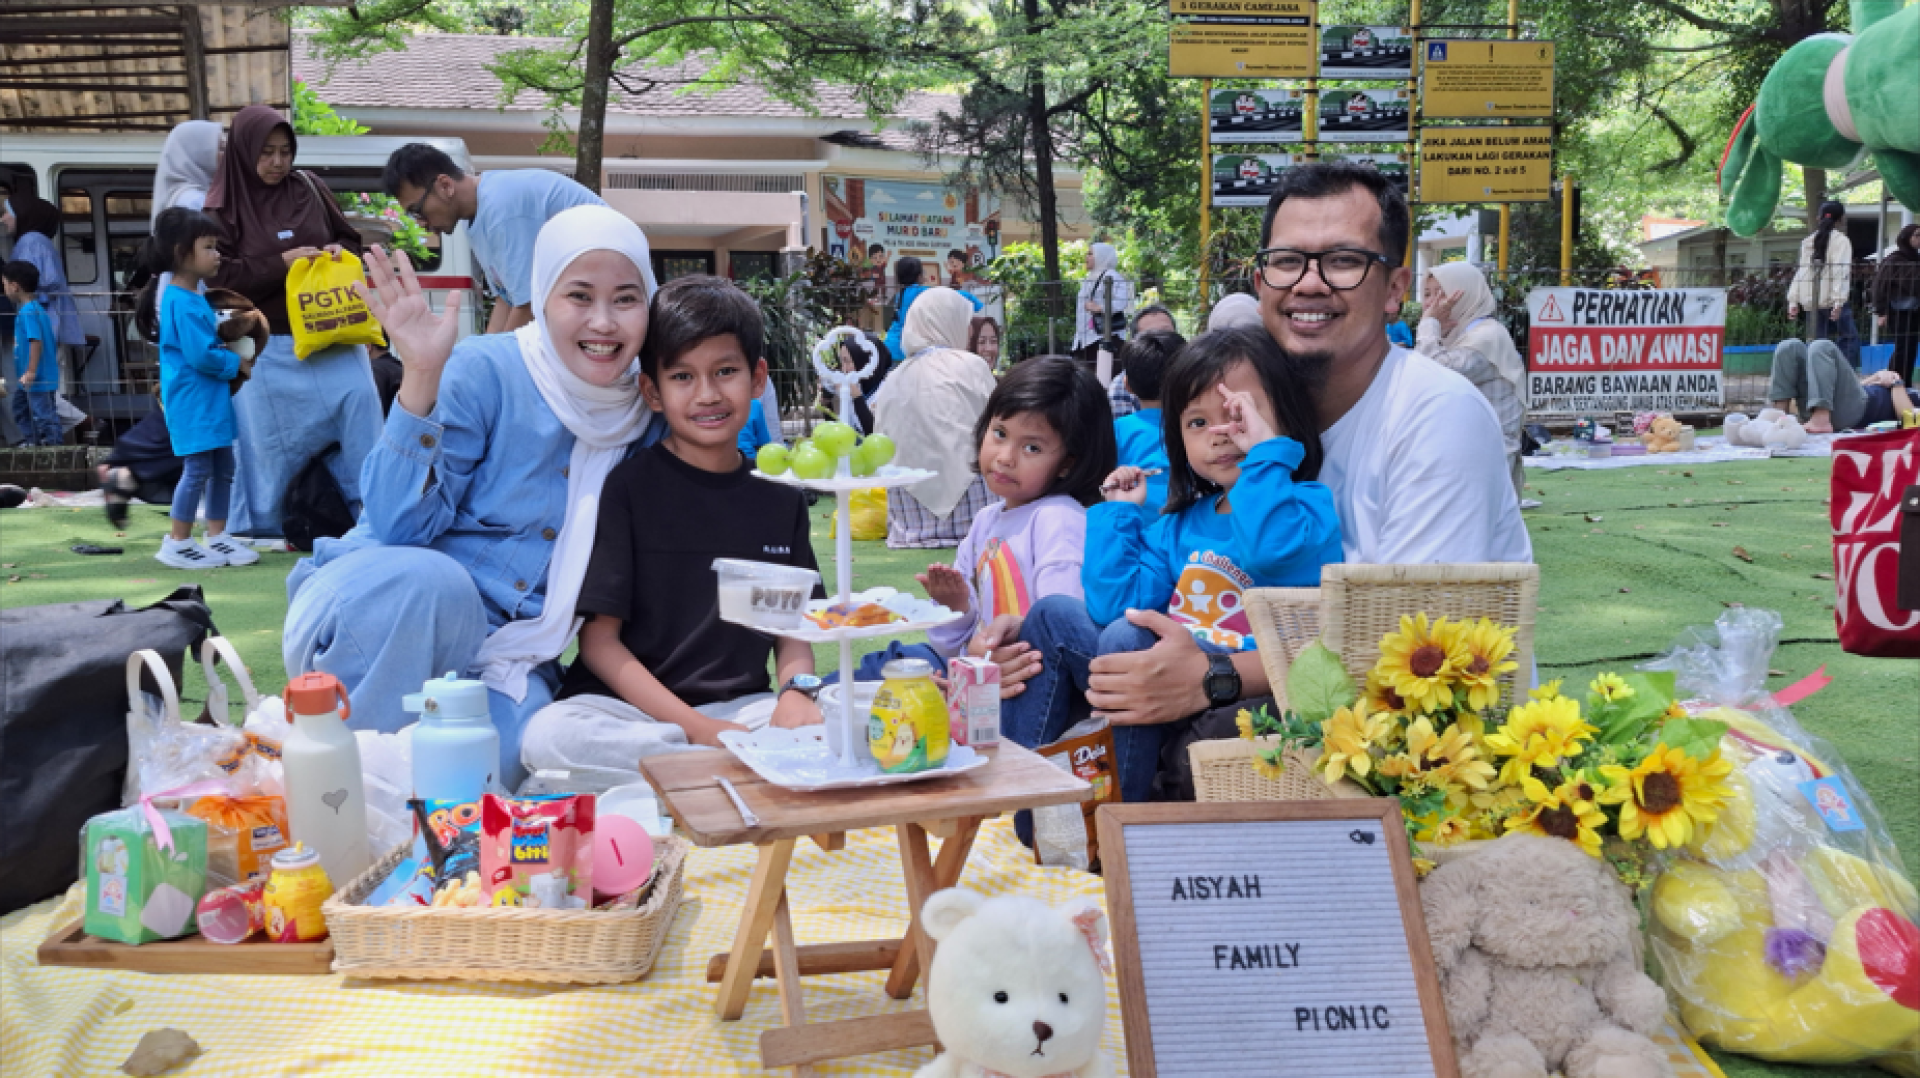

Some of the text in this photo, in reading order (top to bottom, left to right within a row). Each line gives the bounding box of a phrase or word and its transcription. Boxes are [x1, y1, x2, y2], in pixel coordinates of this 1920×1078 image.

[1189, 1, 1241, 11] GERAKAN
[1423, 136, 1552, 147] JIKA JALAN BELUM AMAN
[1423, 151, 1550, 162] LAKUKAN LAGI GERAKAN
[1447, 165, 1472, 176] DARI
[878, 211, 956, 226] SELAMAT DATANG
[886, 225, 919, 237] MURID
[921, 226, 949, 238] BARU
[298, 285, 362, 311] PGTK
[1572, 291, 1686, 325] PERHATIAN
[1535, 333, 1718, 366] JAGA DAN AWASI
[1532, 374, 1719, 395] BARANG BAWAAN ANDA
[1171, 874, 1262, 901] AISYAH
[1213, 943, 1301, 971] FAMILY
[1294, 1005, 1391, 1032] PICNIC
